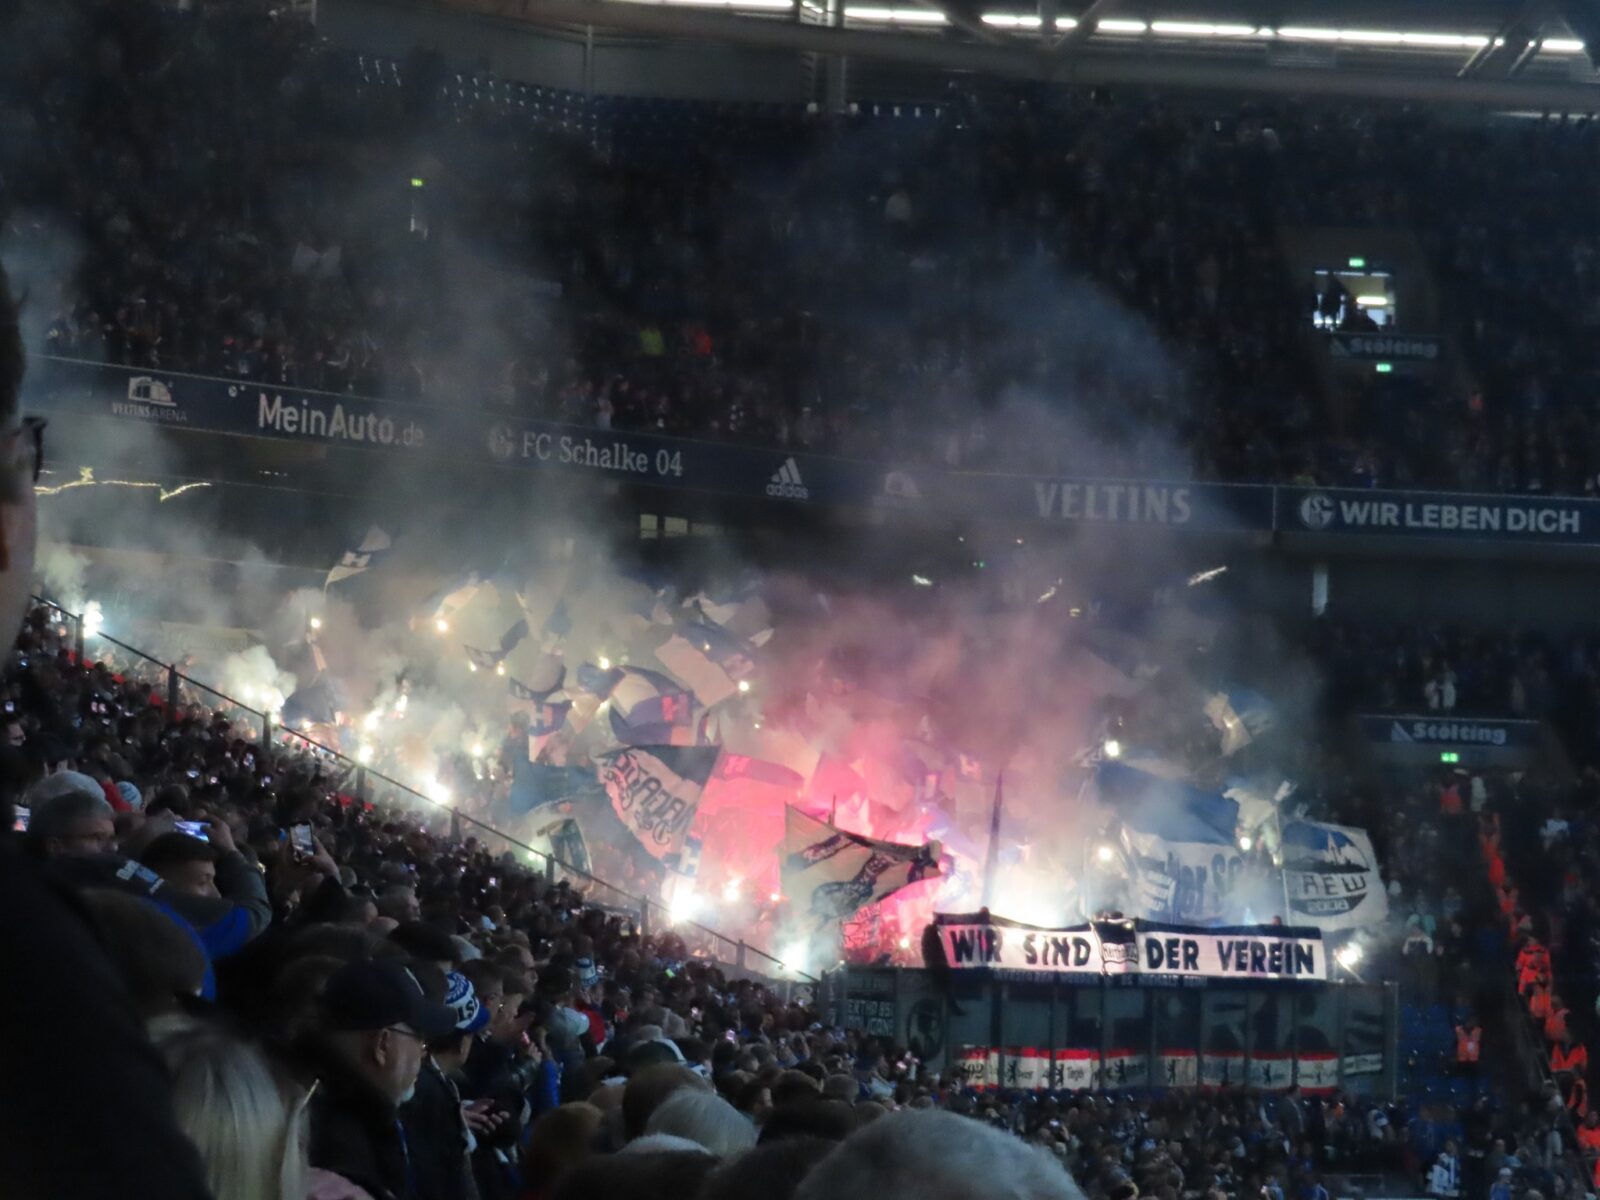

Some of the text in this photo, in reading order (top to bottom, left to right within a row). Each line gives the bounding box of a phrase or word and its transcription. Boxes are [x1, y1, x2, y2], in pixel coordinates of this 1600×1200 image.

[259, 394, 423, 446] MeinAuto.de
[522, 432, 683, 476] FC Schalke 04
[766, 484, 808, 500] adidas
[1034, 483, 1190, 523] VELTINS
[1340, 501, 1580, 533] WIR LEBEN DICH
[950, 929, 999, 963] WIR
[1022, 936, 1091, 966] SIND
[1145, 937, 1199, 970] DER
[1217, 940, 1315, 974] VEREIN
